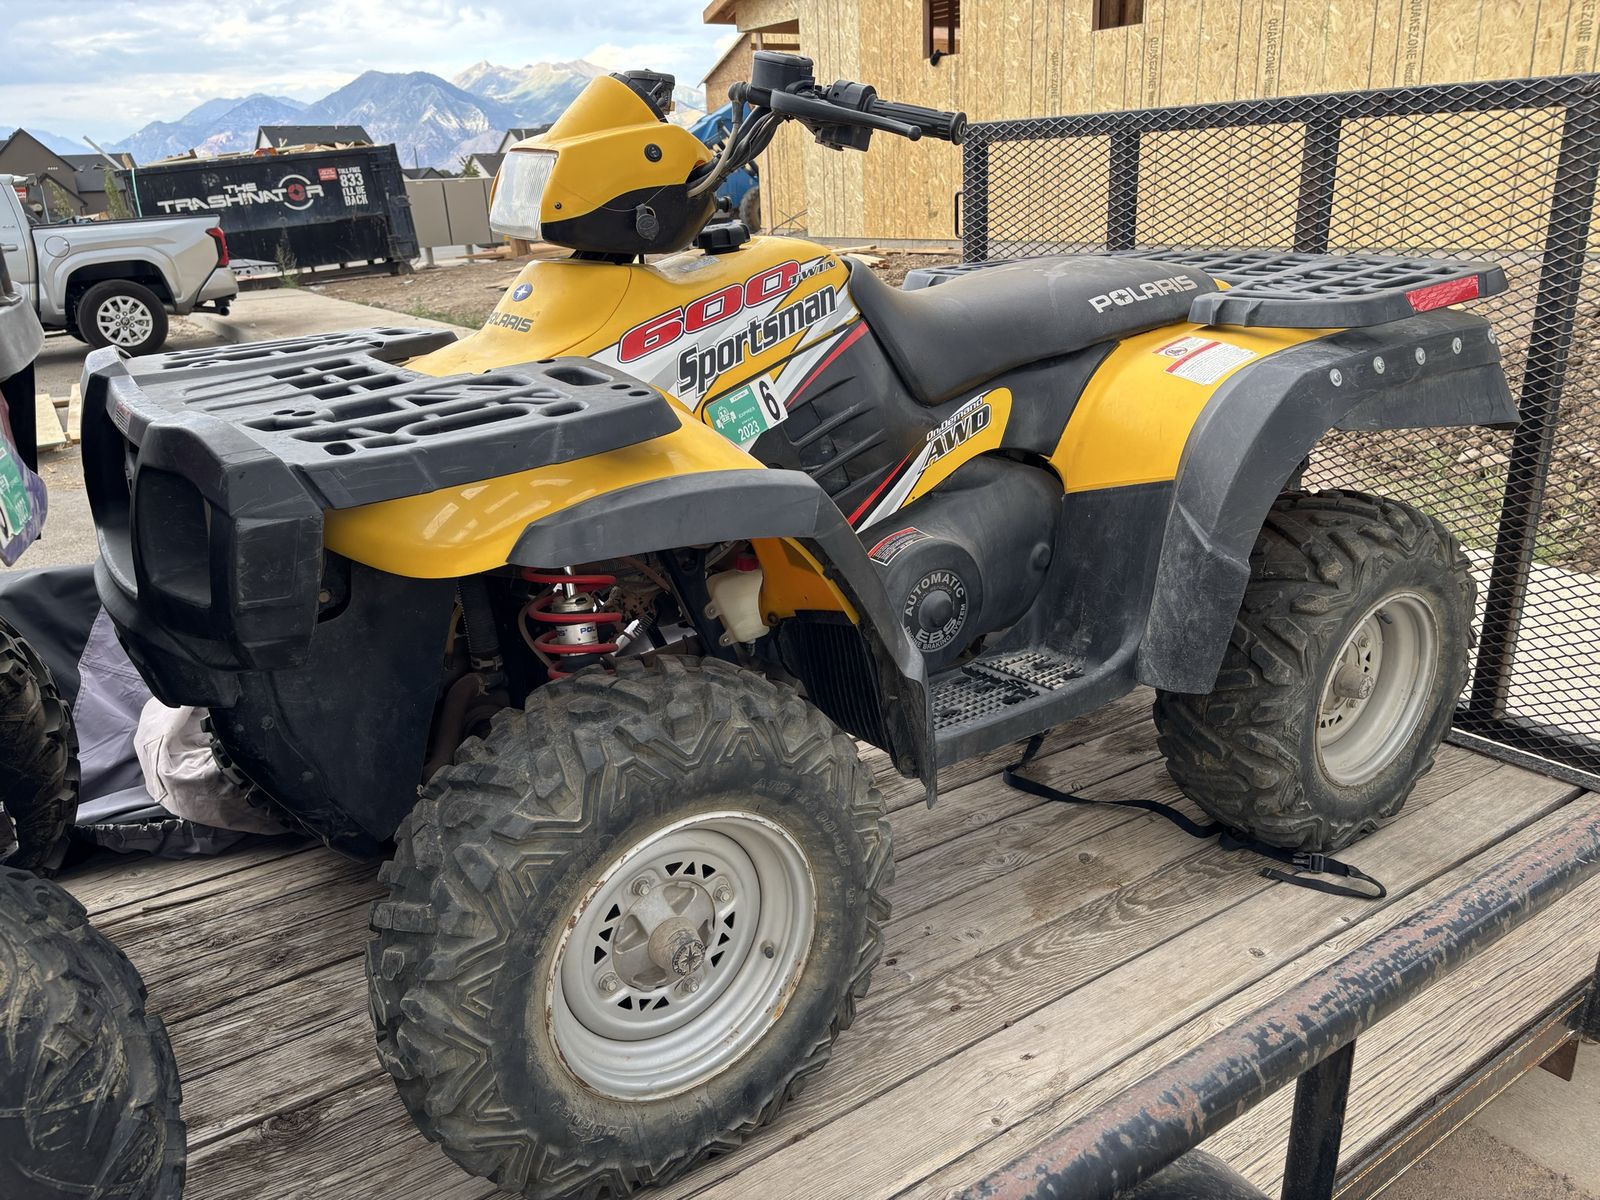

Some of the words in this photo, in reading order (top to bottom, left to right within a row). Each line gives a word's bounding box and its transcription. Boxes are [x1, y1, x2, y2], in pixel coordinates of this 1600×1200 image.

[1264, 18, 1278, 75] QUAKEZONE
[223, 182, 257, 194] THE
[340, 173, 364, 187] 833
[355, 186, 366, 195] BE
[344, 194, 369, 207] BACK
[617, 260, 800, 363] 600
[789, 259, 837, 287] TWIN
[1087, 274, 1199, 314] POLARIS
[676, 284, 838, 398] Sportsman
[758, 380, 781, 421] 6
[737, 420, 760, 441] 2023
[919, 403, 992, 473] AWD
[905, 572, 965, 617] AUTOMATIC
[915, 617, 957, 644] EBS
[922, 635, 951, 650] BRAKING
[952, 603, 966, 635] SYSTEM
